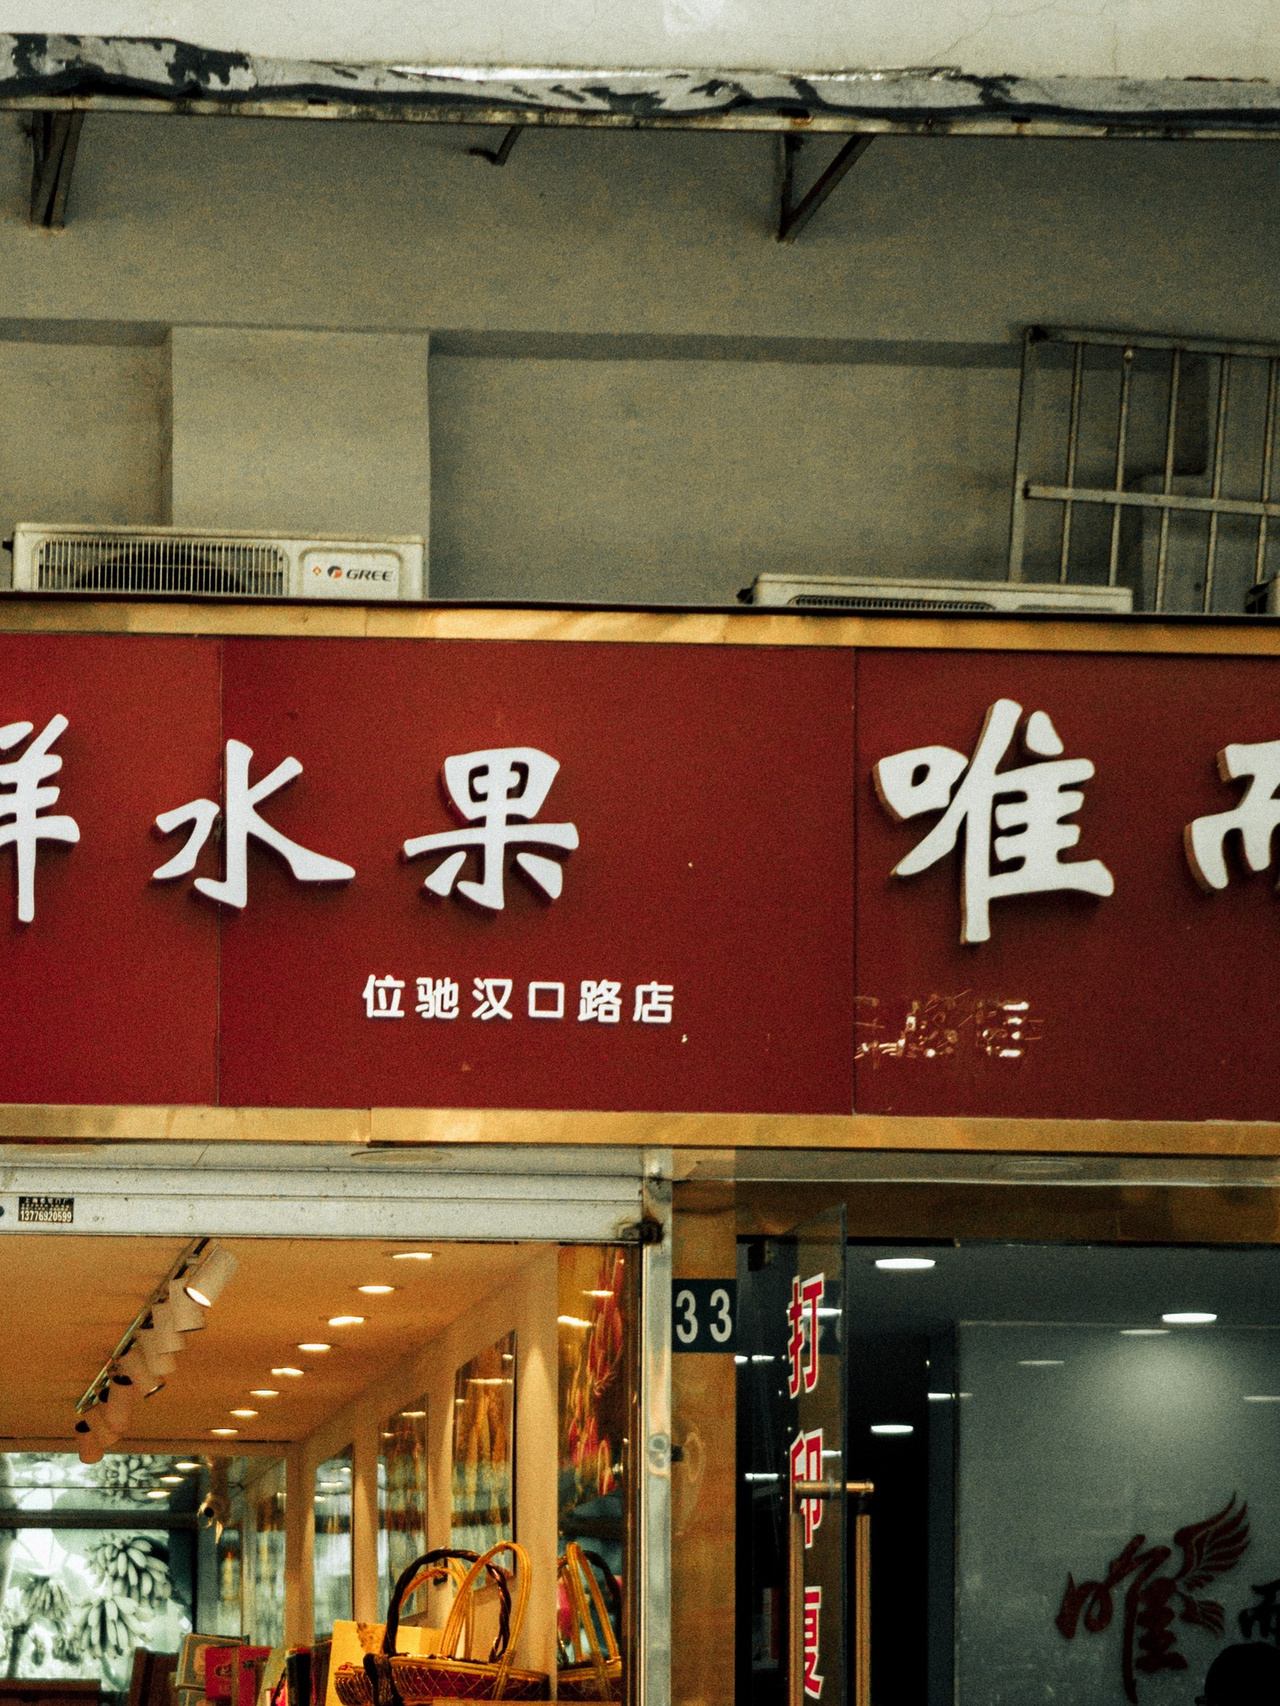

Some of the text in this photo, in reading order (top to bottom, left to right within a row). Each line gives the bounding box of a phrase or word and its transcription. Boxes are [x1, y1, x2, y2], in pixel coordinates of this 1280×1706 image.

[345, 568, 395, 583] GREE
[361, 973, 675, 1025] 位驰汉口路店
[675, 1289, 734, 1345] 33
